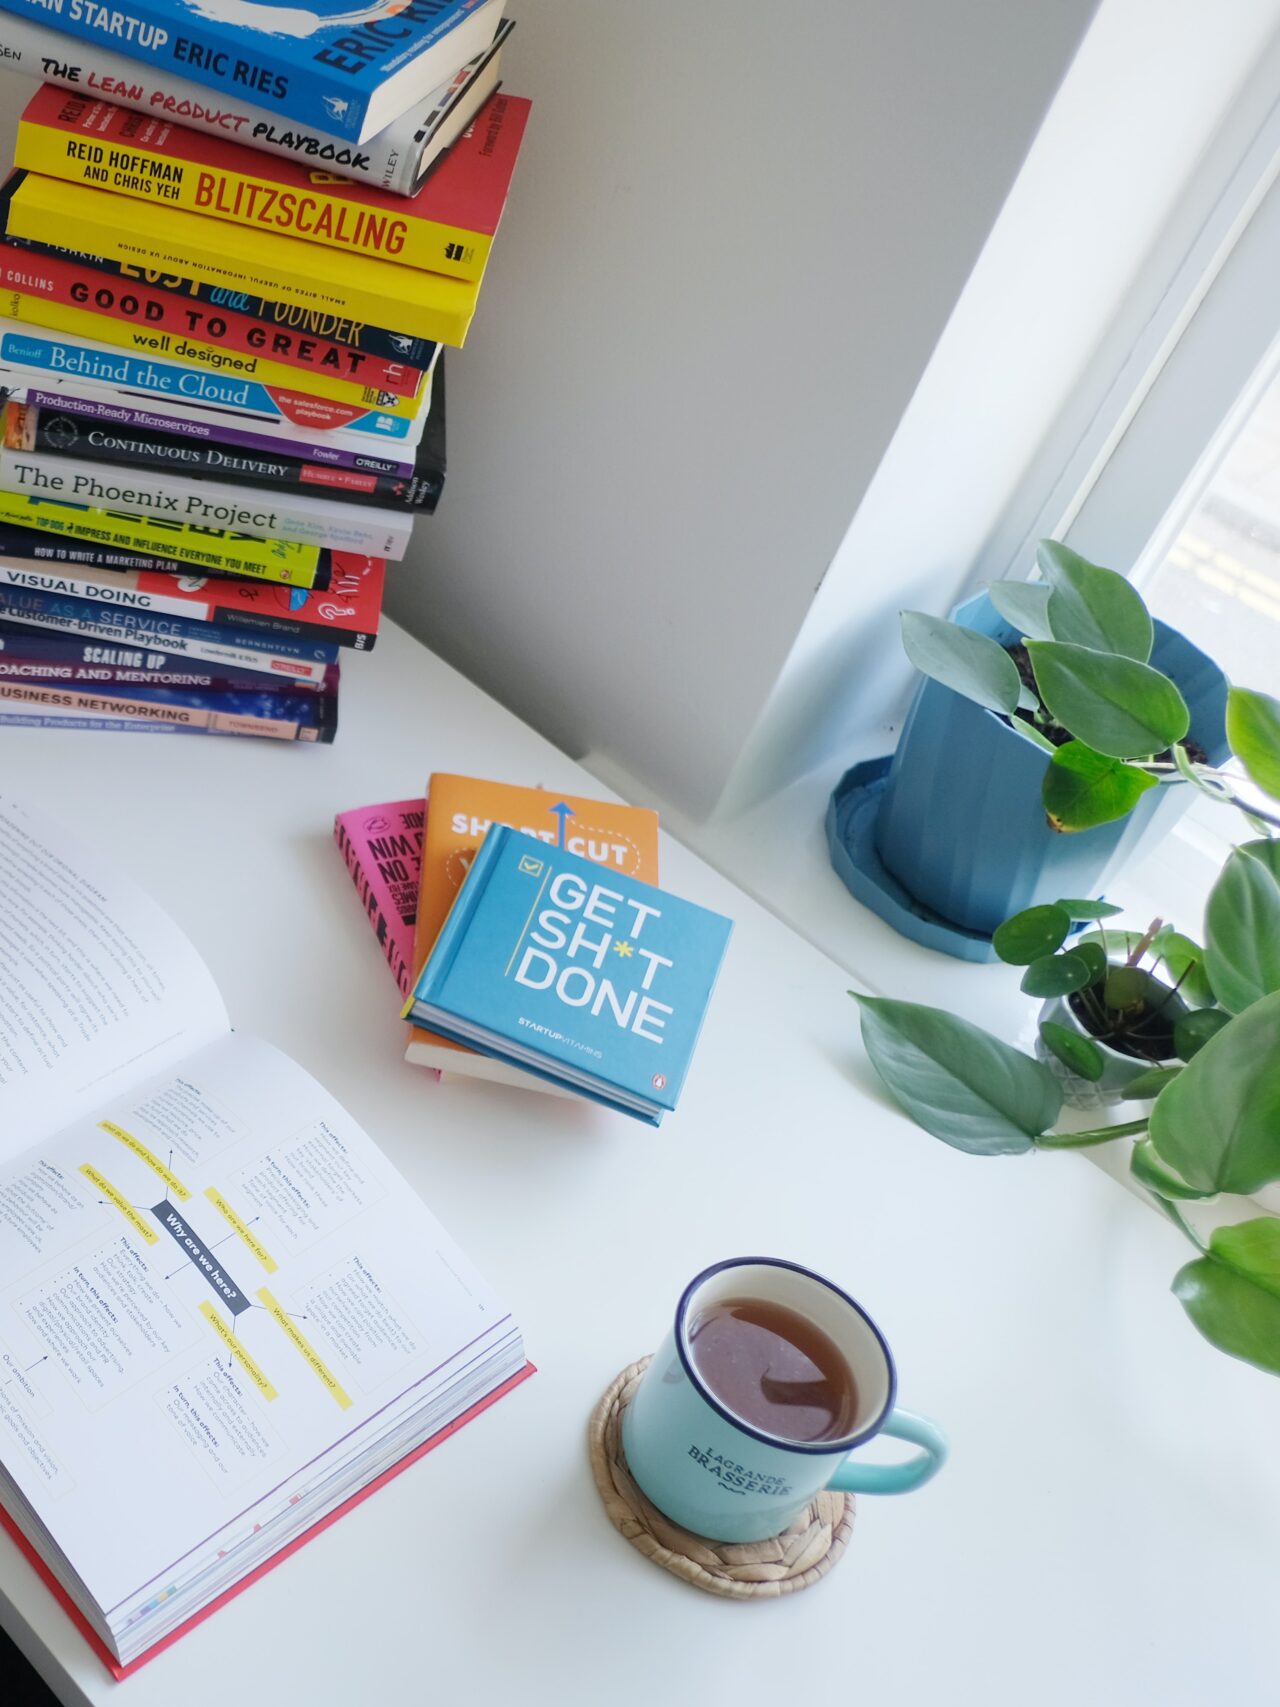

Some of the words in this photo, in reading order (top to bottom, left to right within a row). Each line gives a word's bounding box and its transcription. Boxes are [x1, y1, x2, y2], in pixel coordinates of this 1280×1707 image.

[70, 0, 168, 50] STARTUP
[173, 37, 229, 77] ERIC
[233, 66, 288, 99] RIES
[313, 19, 407, 75] ERIC
[42, 57, 81, 83] THE
[87, 72, 144, 101] LEAN
[150, 90, 250, 133] PRODUCT
[252, 122, 370, 171] PLAYBOOK
[67, 140, 104, 164] REID
[109, 151, 184, 184] HOFFMAN
[382, 149, 400, 189] WILEY
[83, 165, 109, 183] AND
[113, 172, 152, 193] CHRIS
[156, 182, 181, 200] YEH
[195, 172, 408, 254] BLITZSCALING
[116, 242, 147, 255] DESIGN
[162, 254, 189, 265] ABOUT
[7, 269, 54, 291] COLLINS
[190, 261, 247, 280] INFORMATION
[248, 275, 279, 288] USEFUL
[210, 286, 250, 312] and
[294, 287, 317, 298] BITES
[319, 293, 346, 305] SMALL
[71, 282, 164, 322] GOOD
[186, 310, 227, 338] TO
[247, 327, 366, 373] GREAT
[8, 343, 42, 359] Benioff
[133, 332, 170, 351] well
[174, 340, 257, 373] designed
[49, 347, 129, 381] Behind
[136, 365, 171, 390] the
[179, 374, 250, 405] Cloud
[35, 393, 131, 422] Production-Ready
[132, 412, 210, 436] Microservices
[278, 395, 292, 404] the
[294, 397, 353, 417] salesforce.com
[295, 409, 331, 421] playbook
[88, 432, 200, 463] CONTINUOUS
[207, 450, 288, 477] DELIVERY
[313, 449, 340, 460] Fowler
[355, 457, 393, 471] O'REILLY
[15, 465, 64, 490] The
[72, 475, 179, 511] Phoenix
[185, 496, 277, 529] Project
[34, 547, 55, 558] HOW
[56, 549, 67, 560] TO
[69, 551, 95, 563] WRITE
[97, 553, 104, 563] A
[106, 554, 153, 569] MARKETING
[156, 558, 178, 571] PLAN
[36, 516, 50, 526] TOP
[51, 518, 65, 530] DOG
[75, 525, 112, 542] IMPRESS
[113, 532, 131, 544] AND
[133, 535, 177, 556] INFLUENCE
[179, 545, 222, 565] EVERYONE
[225, 557, 241, 568] YOU
[243, 561, 267, 575] MEET
[7, 571, 79, 594] VISUAL
[85, 585, 152, 607] DOING
[9, 606, 126, 637] Customer-Driven
[124, 630, 188, 651] Playbook
[50, 604, 73, 617] AS
[80, 608, 92, 619] A
[100, 611, 182, 636] SERVICE
[226, 613, 270, 628] Willemien
[272, 622, 301, 633] Brand
[83, 647, 143, 668] SCALING
[147, 654, 166, 670] UP
[235, 636, 299, 653] BERNSHTEYN
[75, 669, 112, 680] AND
[116, 671, 211, 686] MENTORING
[0, 714, 42, 726] Building
[44, 717, 87, 727] Products
[89, 720, 102, 729] for
[105, 721, 120, 730] the
[123, 721, 176, 732] Enterprise
[77, 698, 190, 722] NETWORKING
[567, 836, 628, 866] CUT
[548, 872, 662, 940] GET
[514, 947, 674, 1045] DONE
[85, 1167, 99, 1183] What
[97, 1180, 107, 1190] do
[104, 1187, 114, 1197] we
[113, 1195, 127, 1211] value
[125, 1208, 137, 1221] the
[134, 1219, 152, 1239] most?
[214, 1197, 230, 1216] Who
[226, 1213, 238, 1225] are
[234, 1223, 245, 1235] we
[244, 1234, 256, 1247] here
[254, 1247, 267, 1261] for?
[163, 1212, 188, 1240] Why
[182, 1235, 202, 1256] are
[196, 1253, 214, 1273] we
[210, 1270, 237, 1300] here?
[208, 1313, 229, 1337] What's
[225, 1336, 238, 1350] our
[234, 1348, 268, 1389] personality?
[272, 1308, 287, 1325] What
[286, 1326, 305, 1348] makes
[302, 1347, 311, 1357] us
[308, 1356, 336, 1389] different?
[1, 1352, 15, 1368] Our
[11, 1367, 37, 1397] ambition
[687, 1445, 793, 1496] BRASSERIE
[705, 1447, 786, 1485] LAGRANDE
